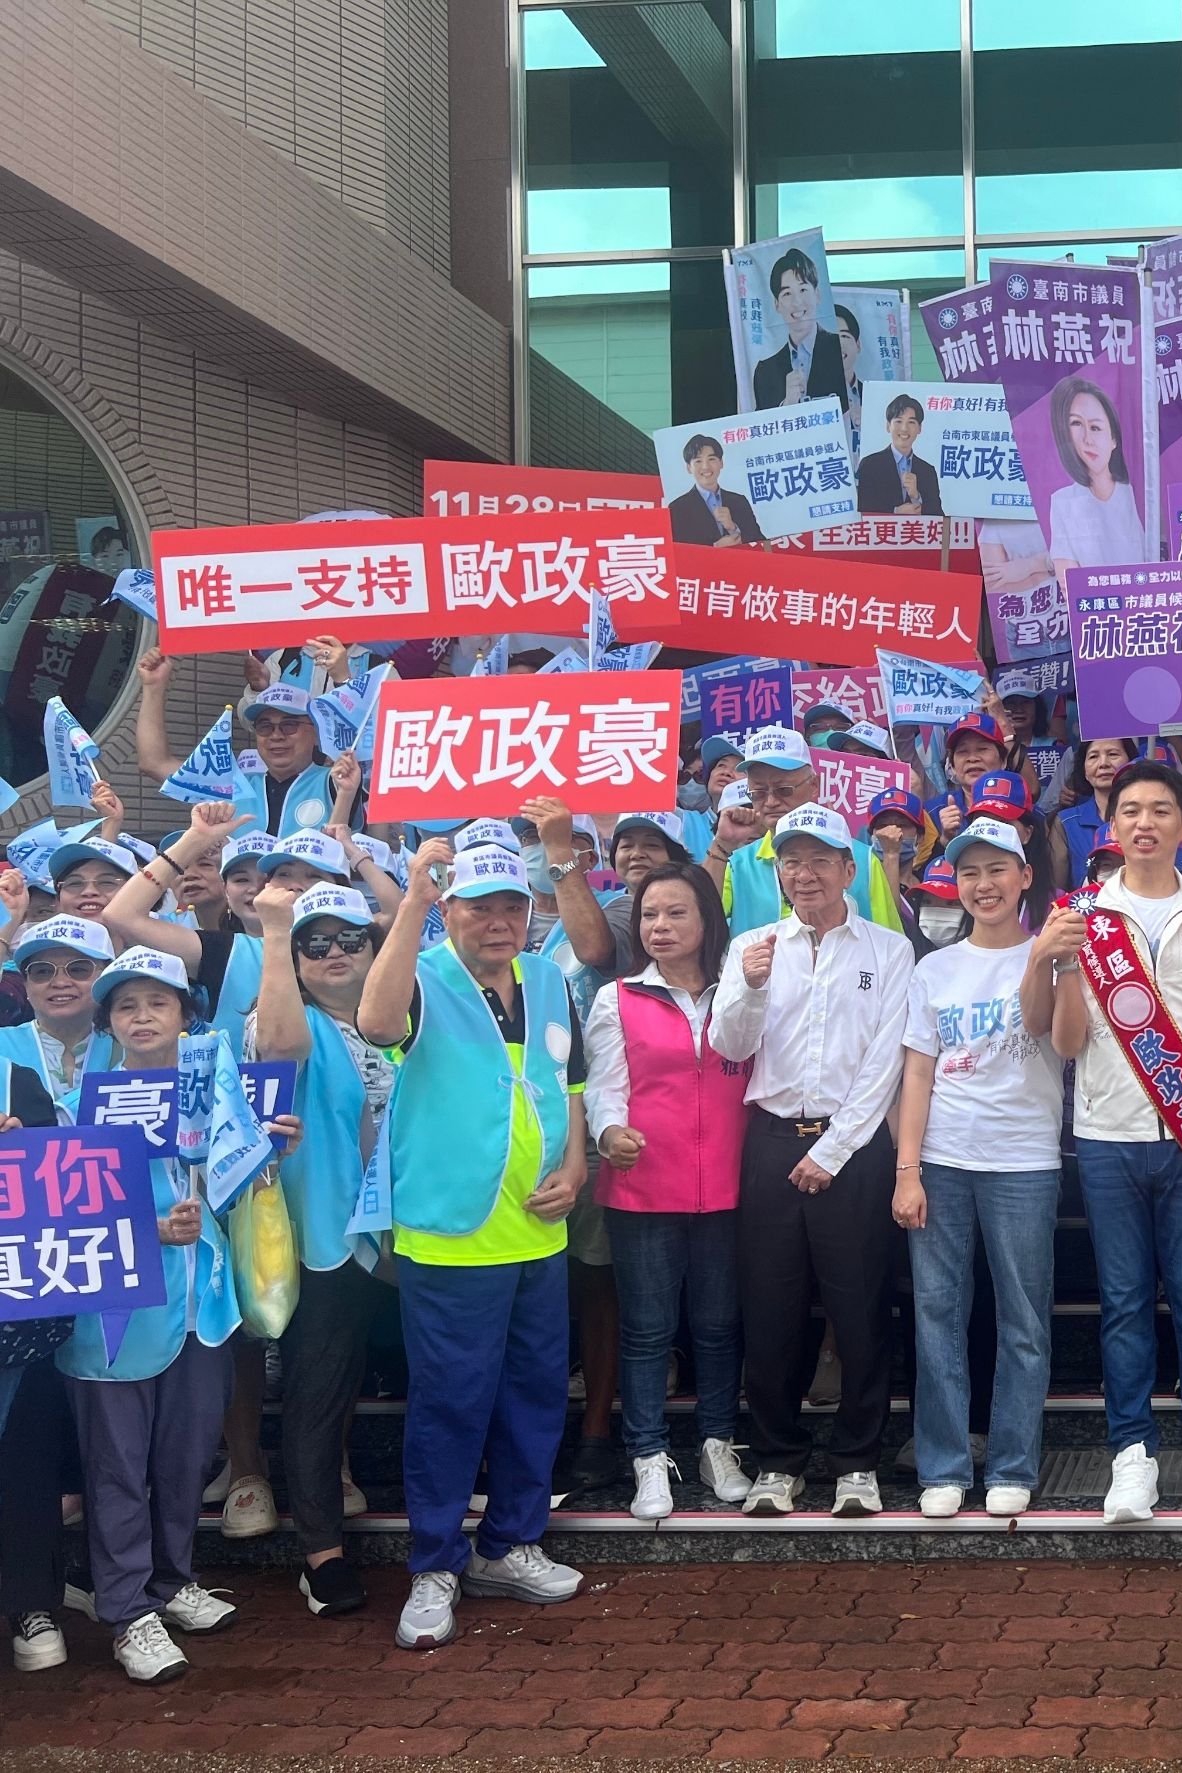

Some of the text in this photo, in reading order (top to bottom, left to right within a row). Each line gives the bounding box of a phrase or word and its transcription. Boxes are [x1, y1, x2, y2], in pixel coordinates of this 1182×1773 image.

[1032, 278, 1125, 306] 臺南市議員
[1002, 309, 1136, 365] 林燕祝
[745, 442, 845, 469] 台南市東區議員參選人
[747, 456, 852, 506] 歐政豪
[178, 534, 671, 617] 唯一支持 歐政豪
[1078, 597, 1120, 611] 永康區
[709, 677, 782, 727] 有你
[377, 697, 671, 795] 歐政豪
[474, 863, 518, 877] 歐政豪
[1090, 915, 1135, 981] 東區
